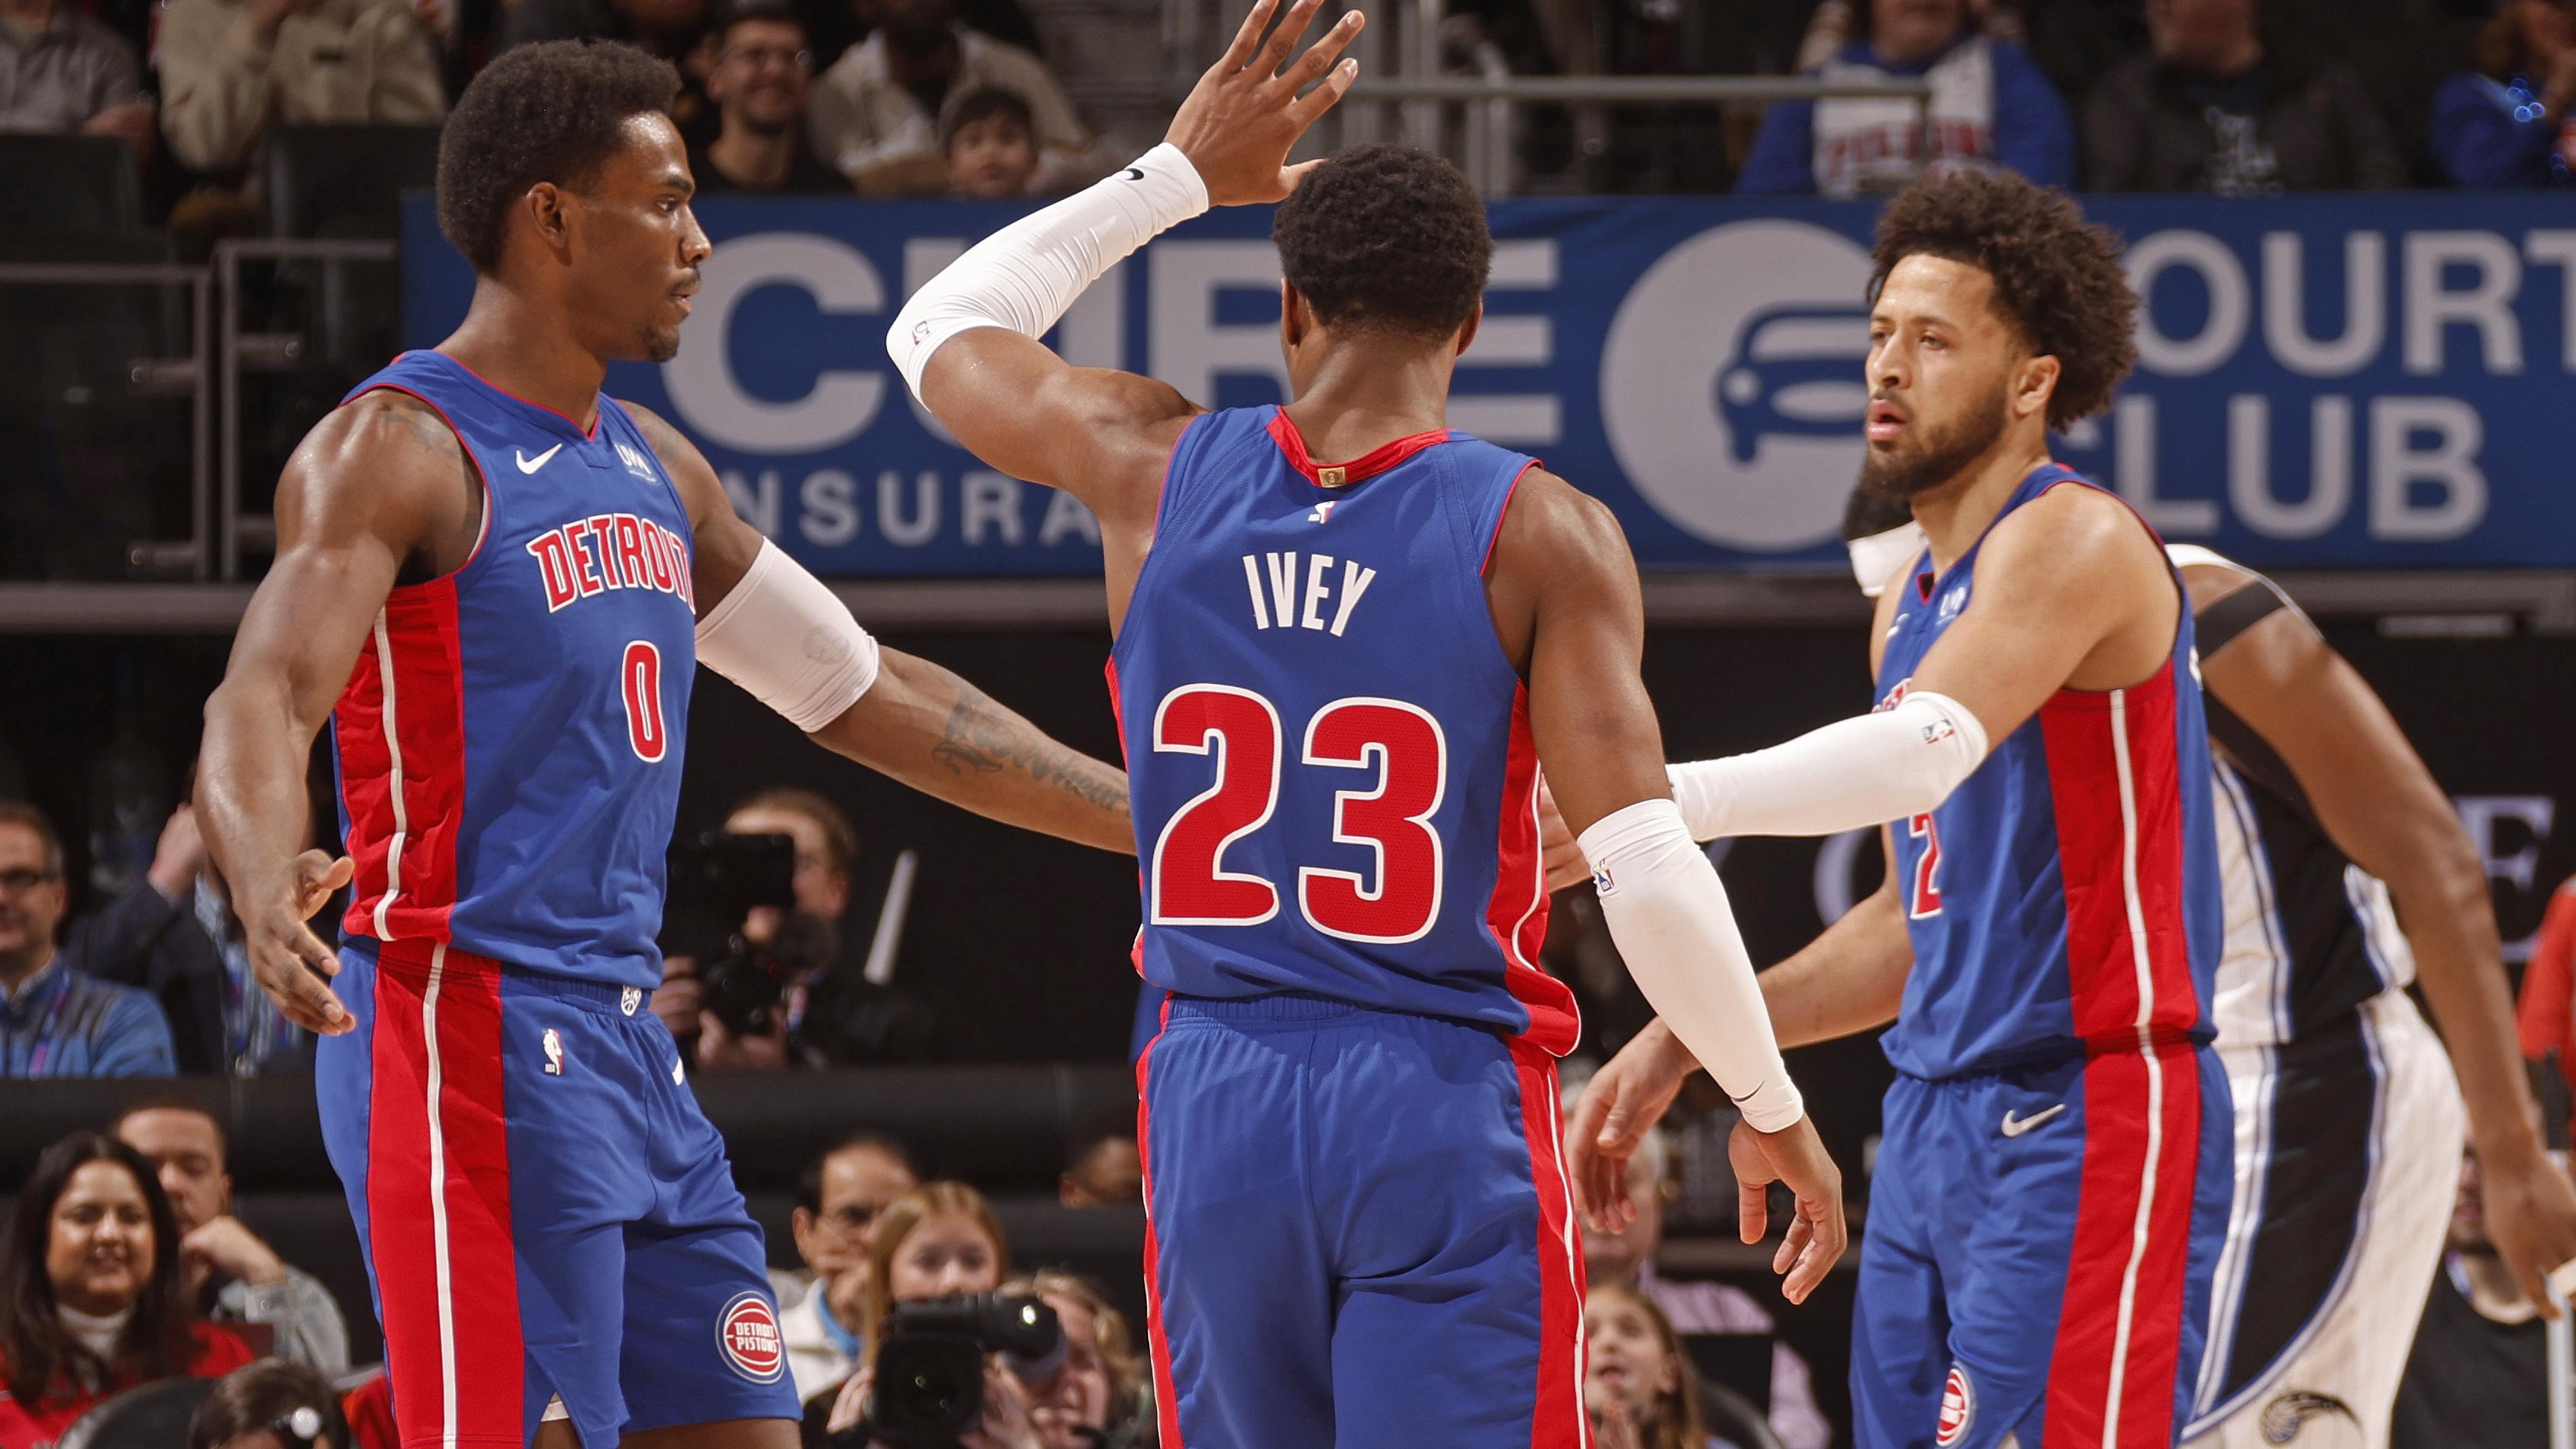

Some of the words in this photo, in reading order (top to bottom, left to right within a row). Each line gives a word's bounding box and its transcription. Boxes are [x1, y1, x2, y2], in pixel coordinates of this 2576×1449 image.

[2062, 392, 2491, 540] LUB
[526, 513, 696, 615] DETROIT
[1242, 550, 1376, 637] IVEY
[621, 640, 666, 763] 0
[1151, 683, 1446, 944] 23
[1910, 812, 1943, 920] 2
[734, 1322, 774, 1339] DETROIT
[735, 1337, 777, 1354] PISTONS
